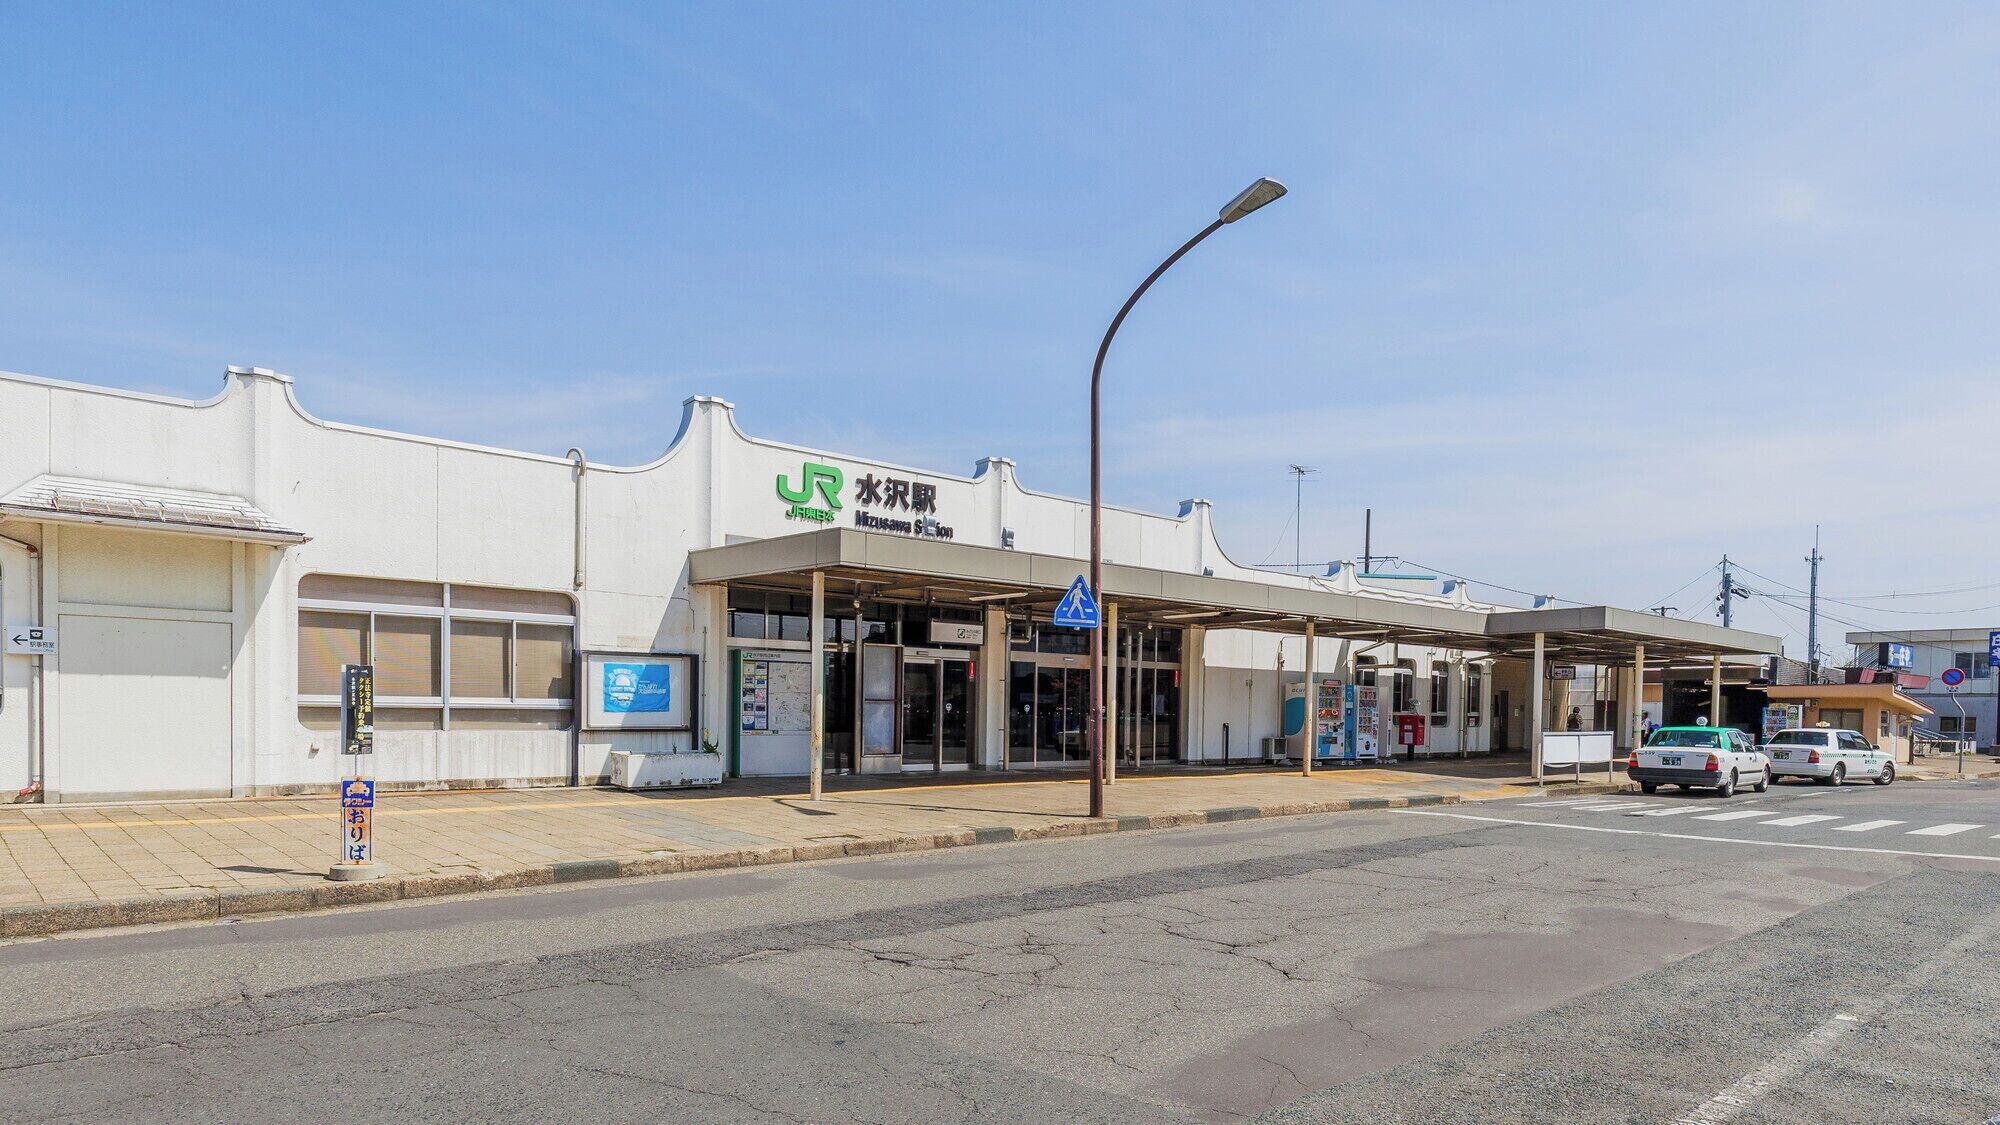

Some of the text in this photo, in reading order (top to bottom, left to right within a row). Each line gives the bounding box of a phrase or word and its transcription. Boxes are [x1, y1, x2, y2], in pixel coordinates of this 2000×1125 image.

[776, 462, 844, 509] JR
[856, 473, 937, 514] 水沢駅
[787, 505, 836, 522] JR東日本
[855, 510, 954, 539] Mizusawa Sion
[347, 808, 367, 861] おりば
